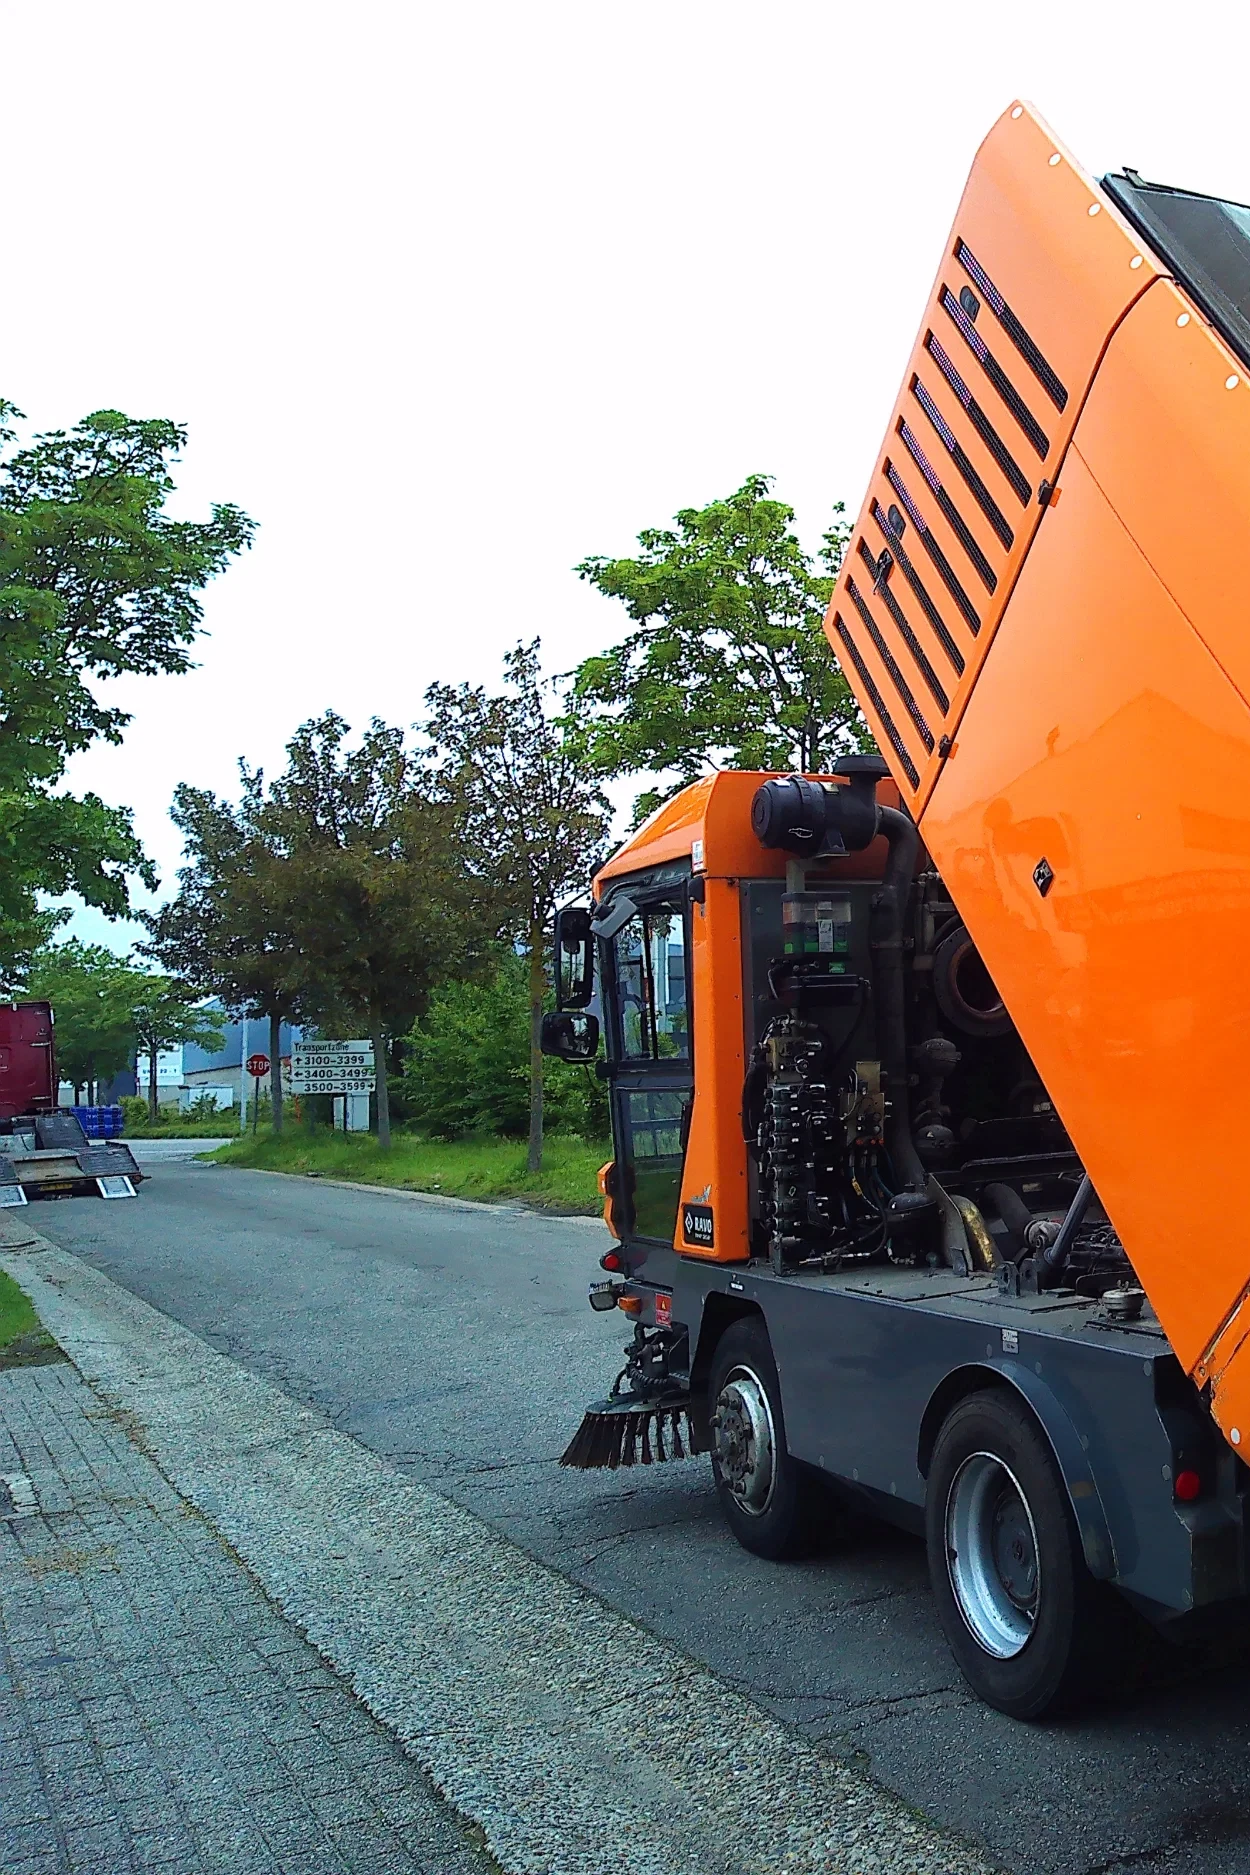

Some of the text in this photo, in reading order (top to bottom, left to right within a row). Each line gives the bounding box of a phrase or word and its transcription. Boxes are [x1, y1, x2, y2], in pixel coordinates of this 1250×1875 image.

[294, 1042, 350, 1054] Transportzone
[247, 1060, 271, 1071] STOP
[304, 1055, 365, 1066] 3100-3399
[304, 1069, 368, 1079] 3400-3499
[304, 1082, 366, 1092] 3500-3599
[694, 1216, 712, 1234] RAVO
